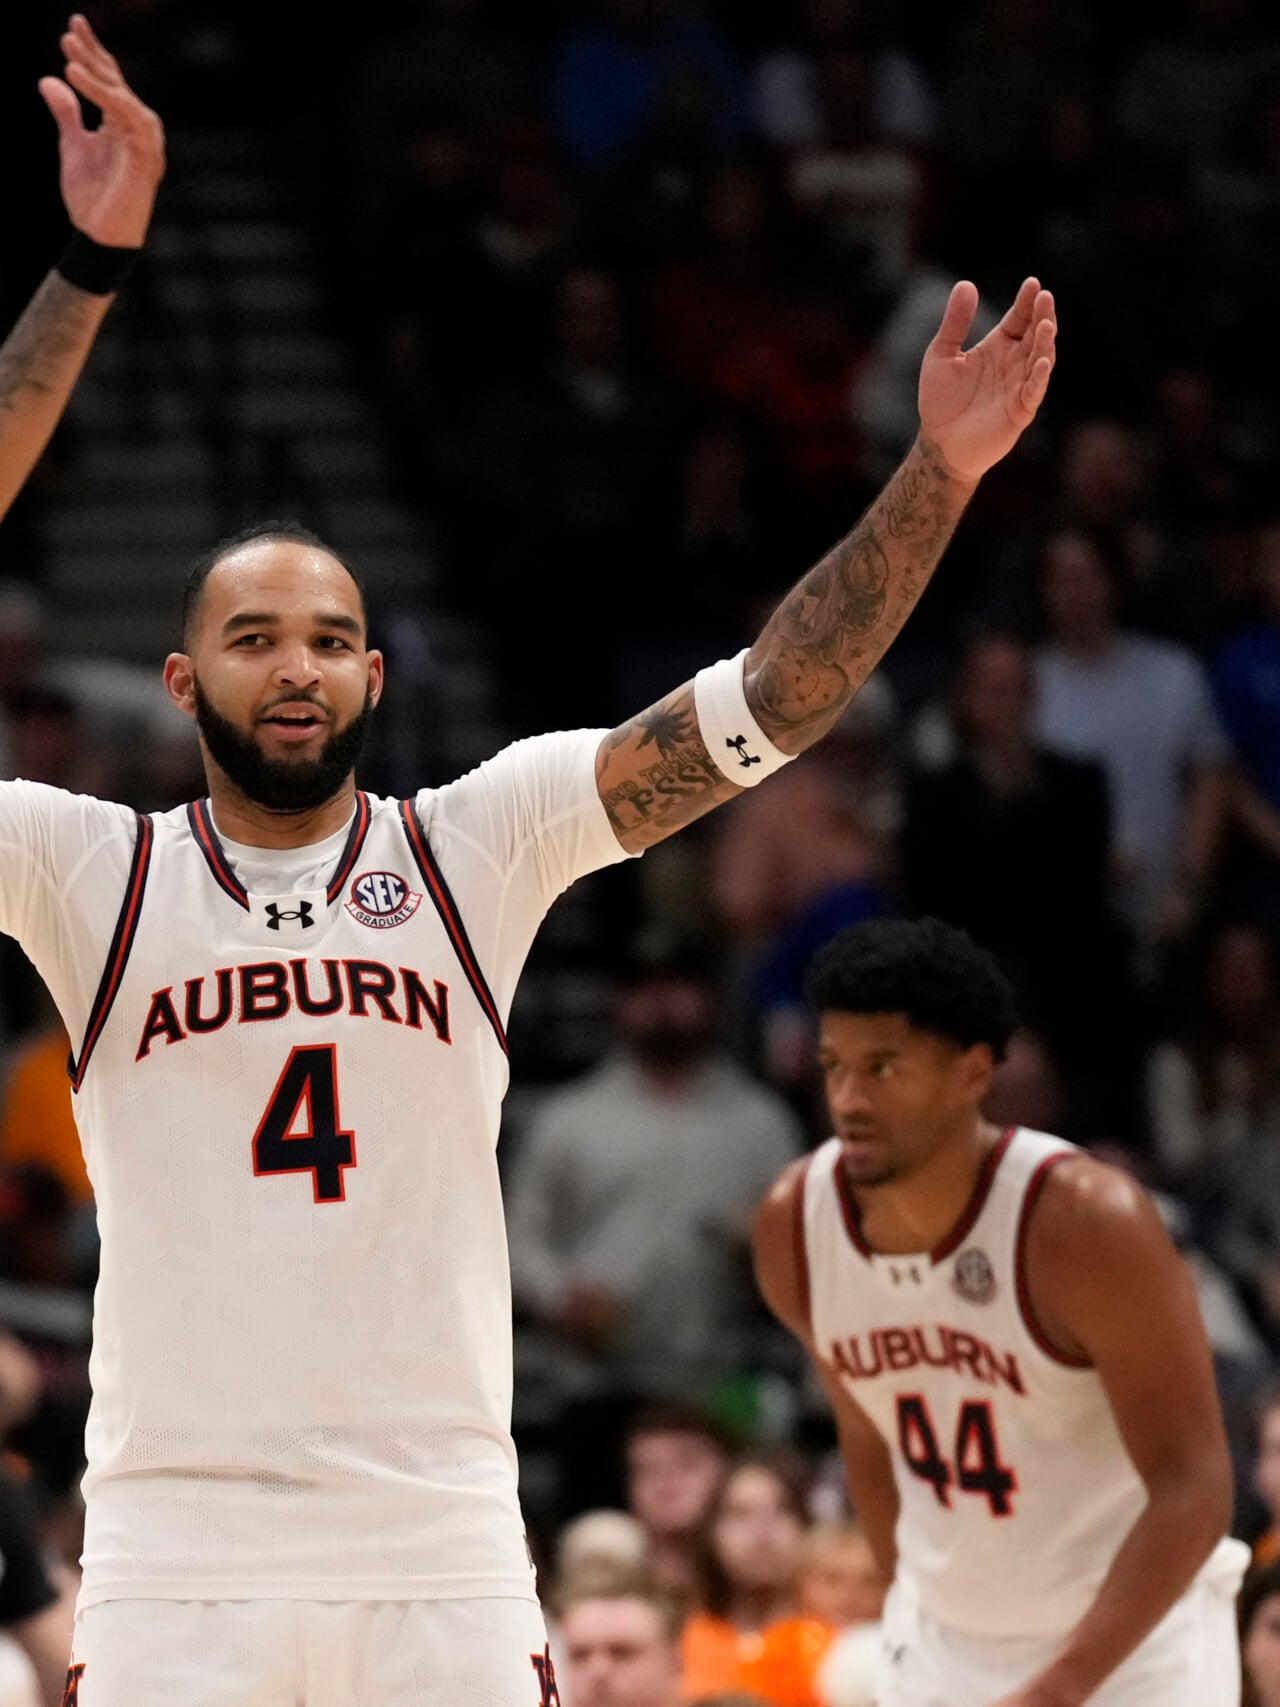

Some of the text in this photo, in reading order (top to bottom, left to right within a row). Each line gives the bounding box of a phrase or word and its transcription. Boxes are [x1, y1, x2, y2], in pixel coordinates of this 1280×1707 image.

[355, 873, 406, 913] SEC
[355, 904, 414, 928] GRADUATE
[135, 958, 452, 1063] AUBURN
[251, 1043, 357, 1204] 4
[895, 1392, 1018, 1519] 44
